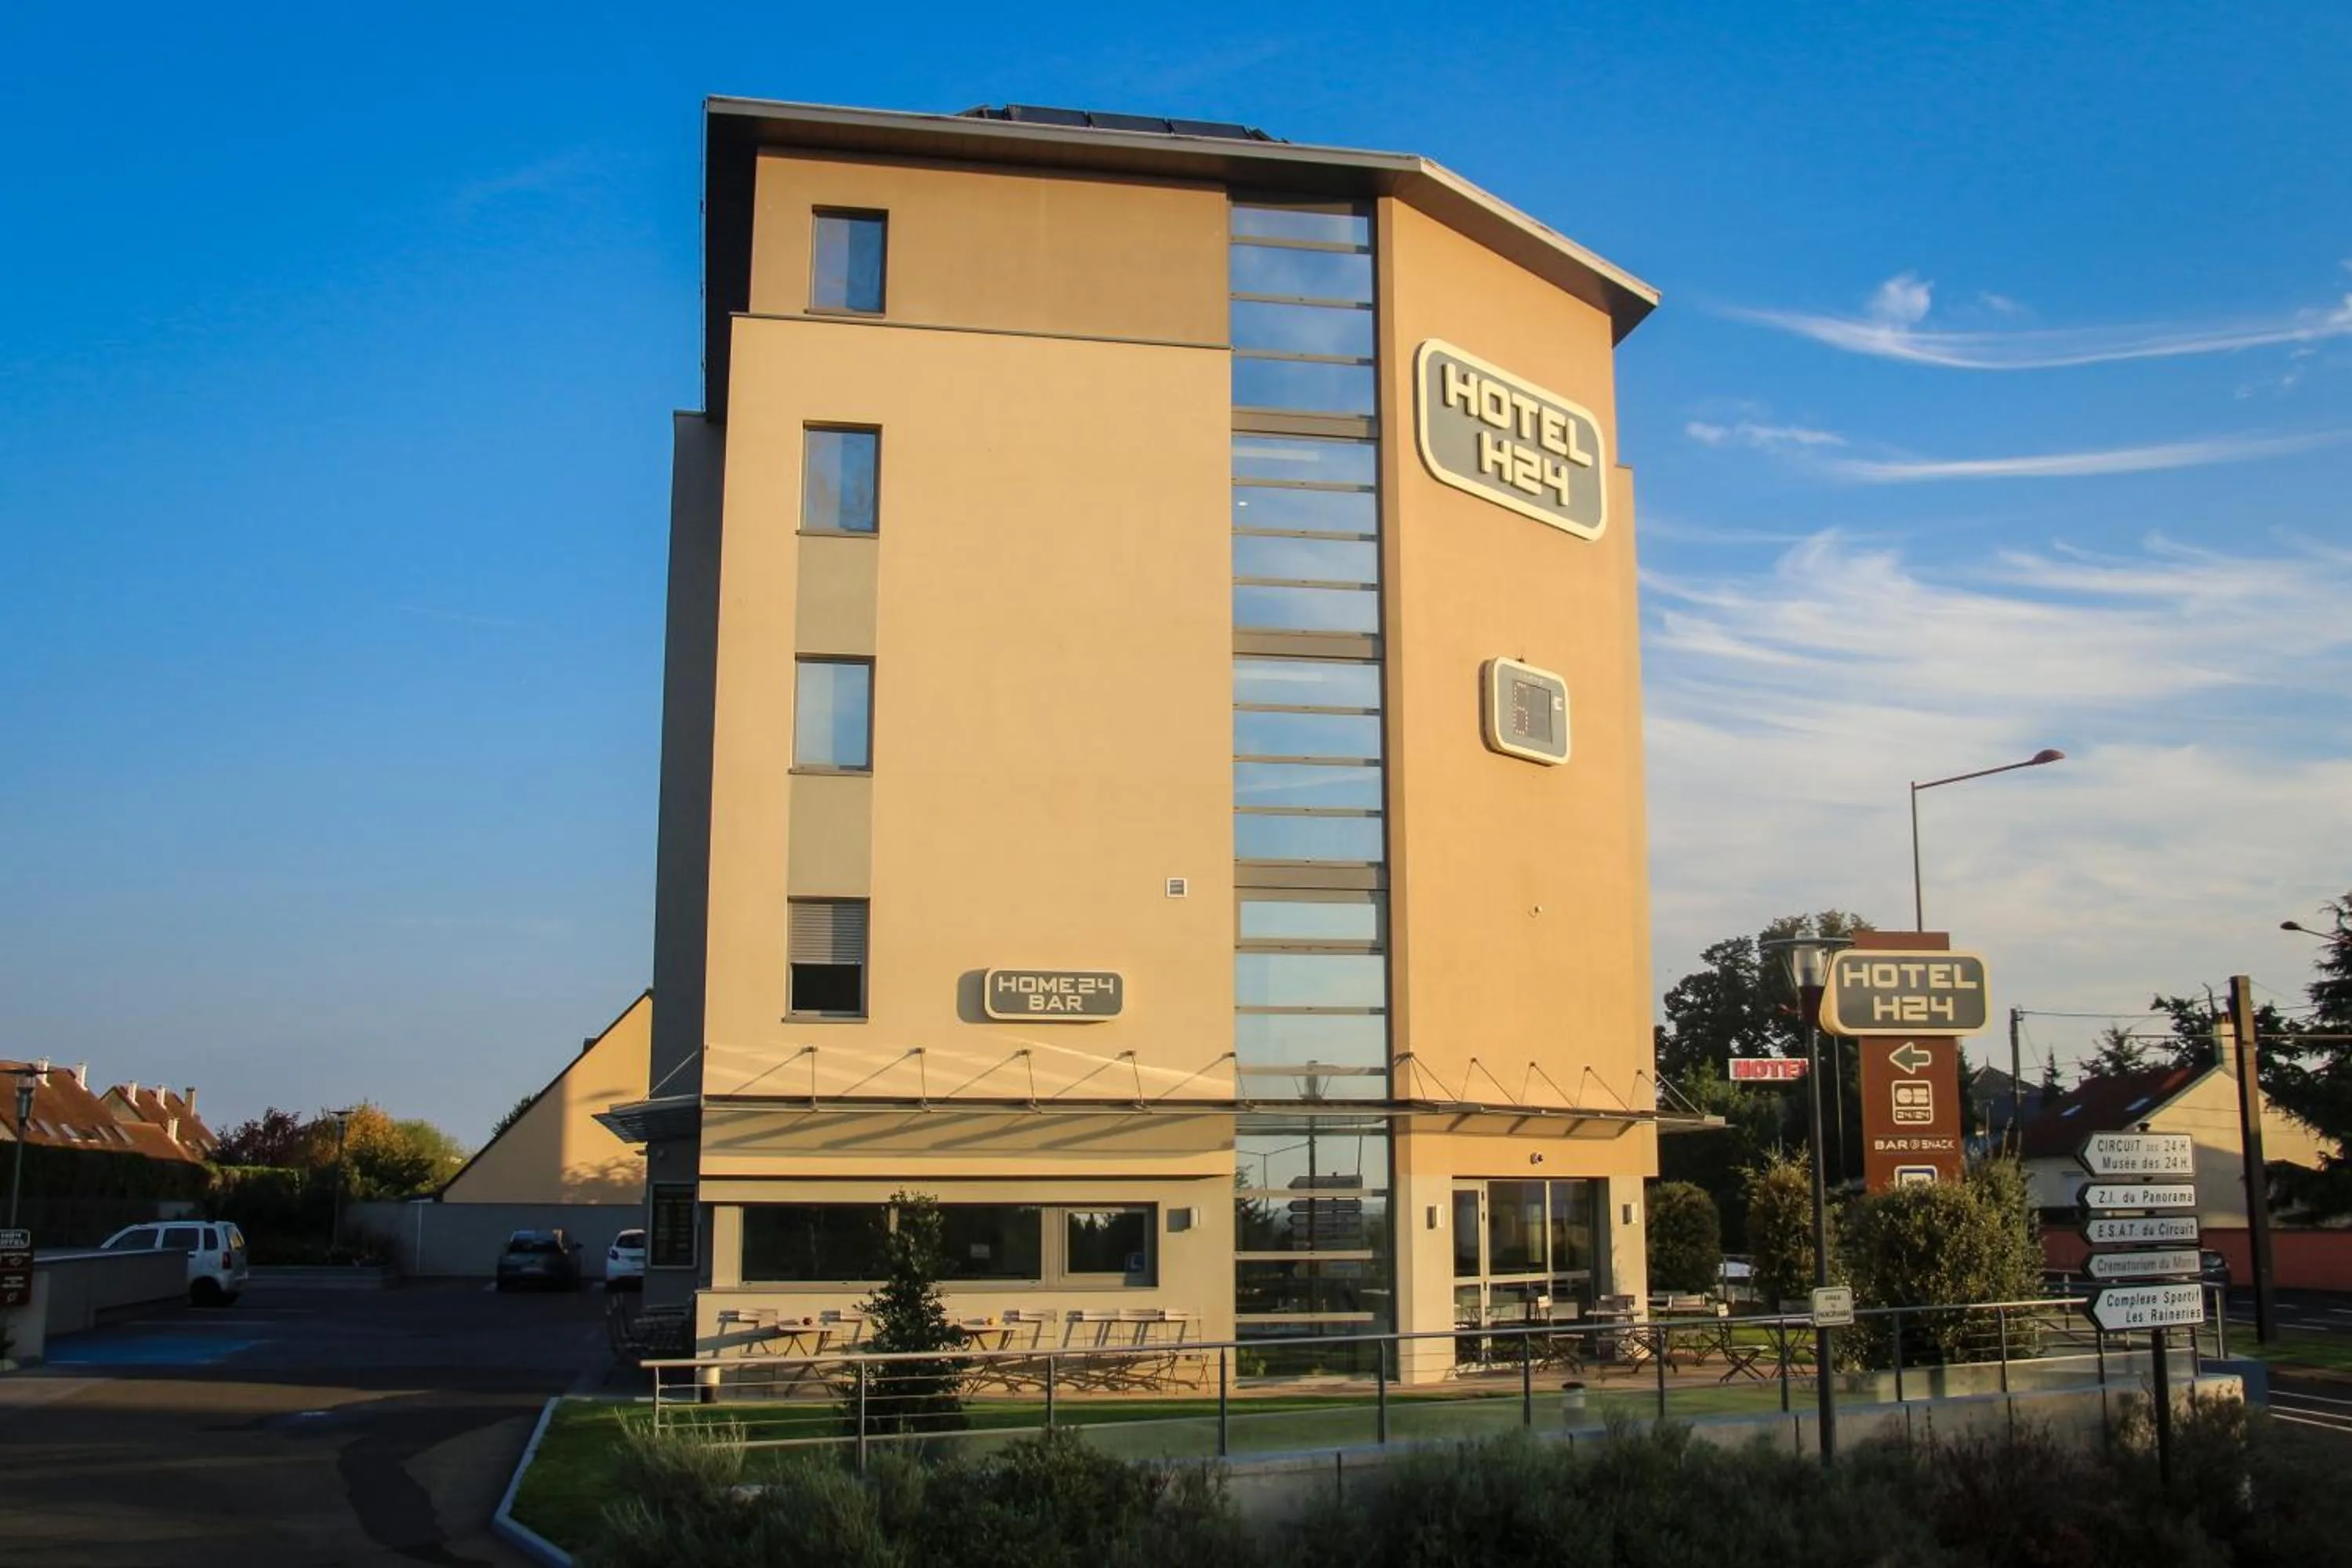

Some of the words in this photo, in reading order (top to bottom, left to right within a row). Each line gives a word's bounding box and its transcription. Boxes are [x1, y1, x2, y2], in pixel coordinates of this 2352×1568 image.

[1443, 362, 1593, 466] HOTEL
[1479, 430, 1569, 506] H24
[1842, 963, 1977, 989] HOTEL
[997, 975, 1114, 995] HOME24
[1028, 994, 1084, 1011] BAR
[1873, 996, 1955, 1022] H24
[1875, 1139, 1909, 1151] BAR
[2097, 1139, 2141, 1152] CIRCUIT
[2164, 1139, 2177, 1152] 24
[2102, 1156, 2136, 1169] Musée
[2141, 1156, 2159, 1169] des
[2164, 1156, 2178, 1169] 24
[2122, 1192, 2135, 1203] du
[2143, 1189, 2193, 1203] Panorama
[2142, 1224, 2154, 1236] du
[2158, 1222, 2194, 1236] Circuit
[2107, 1292, 2157, 1308] Complexe
[2164, 1287, 2200, 1306] Sportif
[2125, 1310, 2143, 1323] Les
[2151, 1308, 2201, 1322] Raineries
